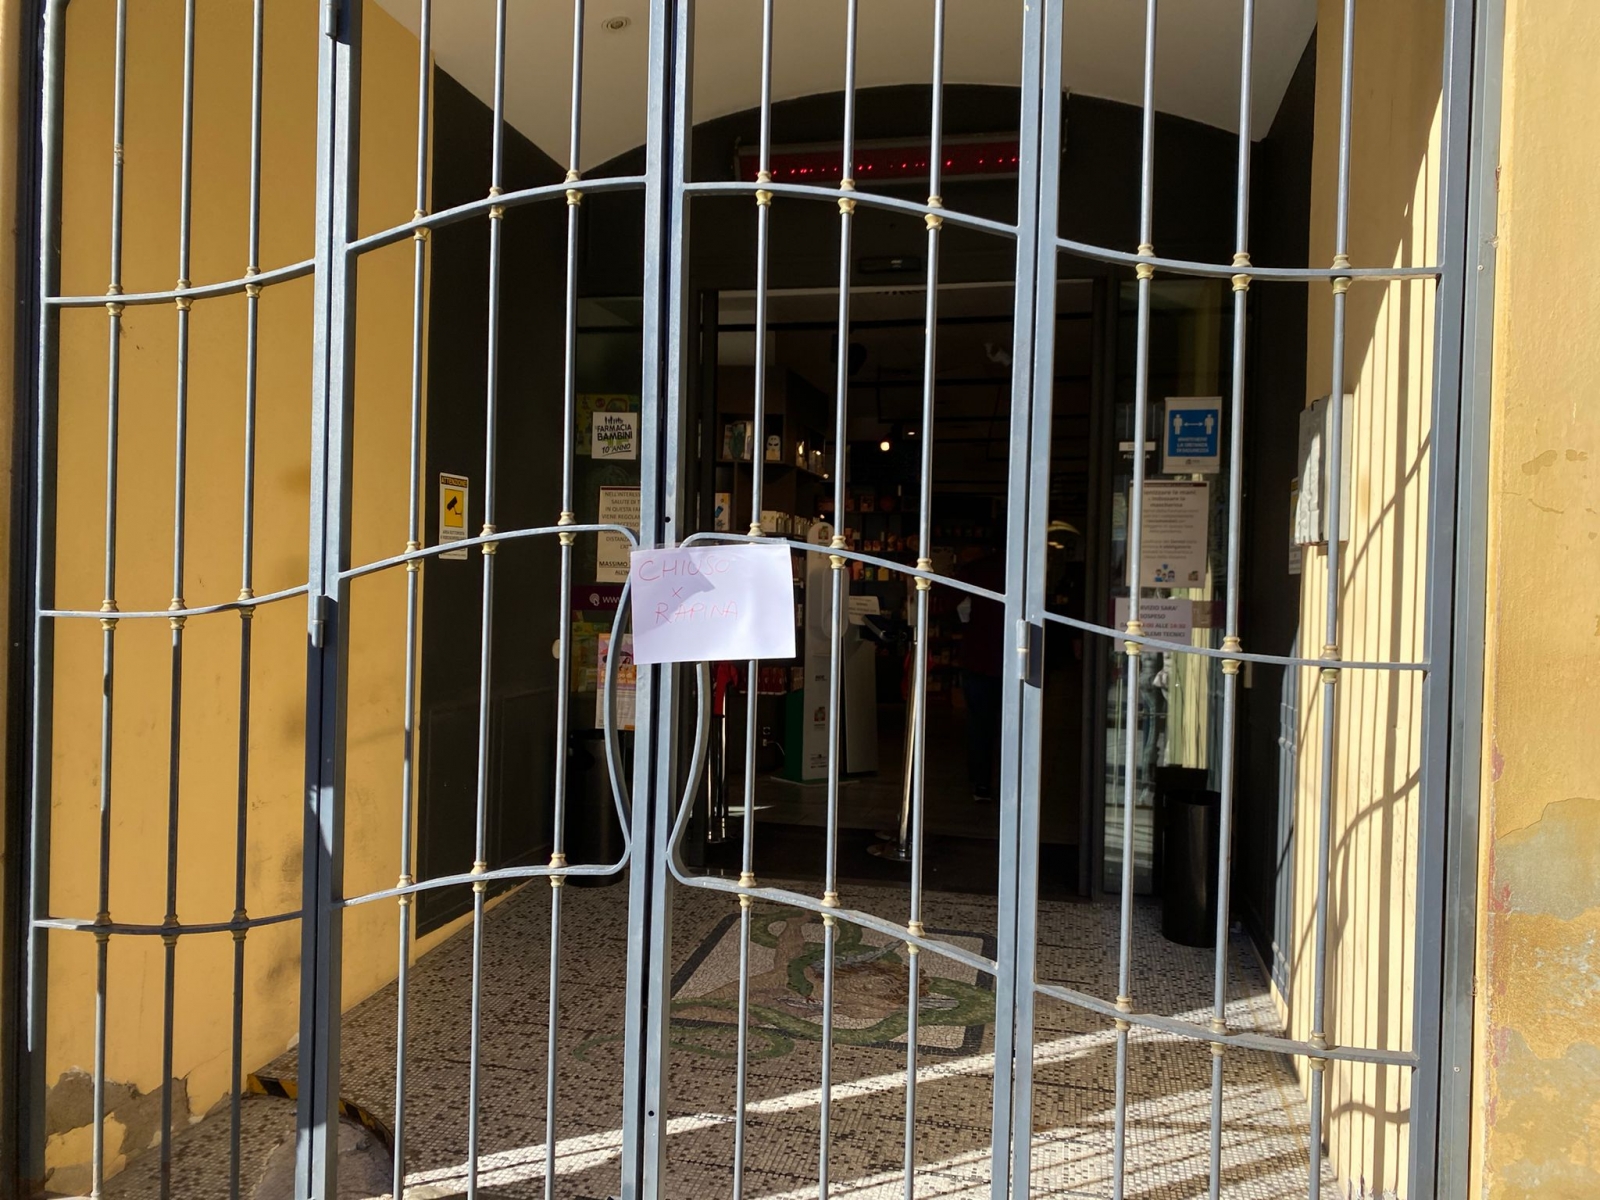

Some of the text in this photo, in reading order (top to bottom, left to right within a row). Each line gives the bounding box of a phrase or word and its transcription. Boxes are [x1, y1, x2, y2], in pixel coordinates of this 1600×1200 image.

[597, 424, 632, 433] FARMACIA
[597, 431, 633, 441] BAMBINI
[612, 443, 631, 452] ANNO
[638, 554, 732, 582] CHIUSO
[655, 600, 739, 625] RAPINA
